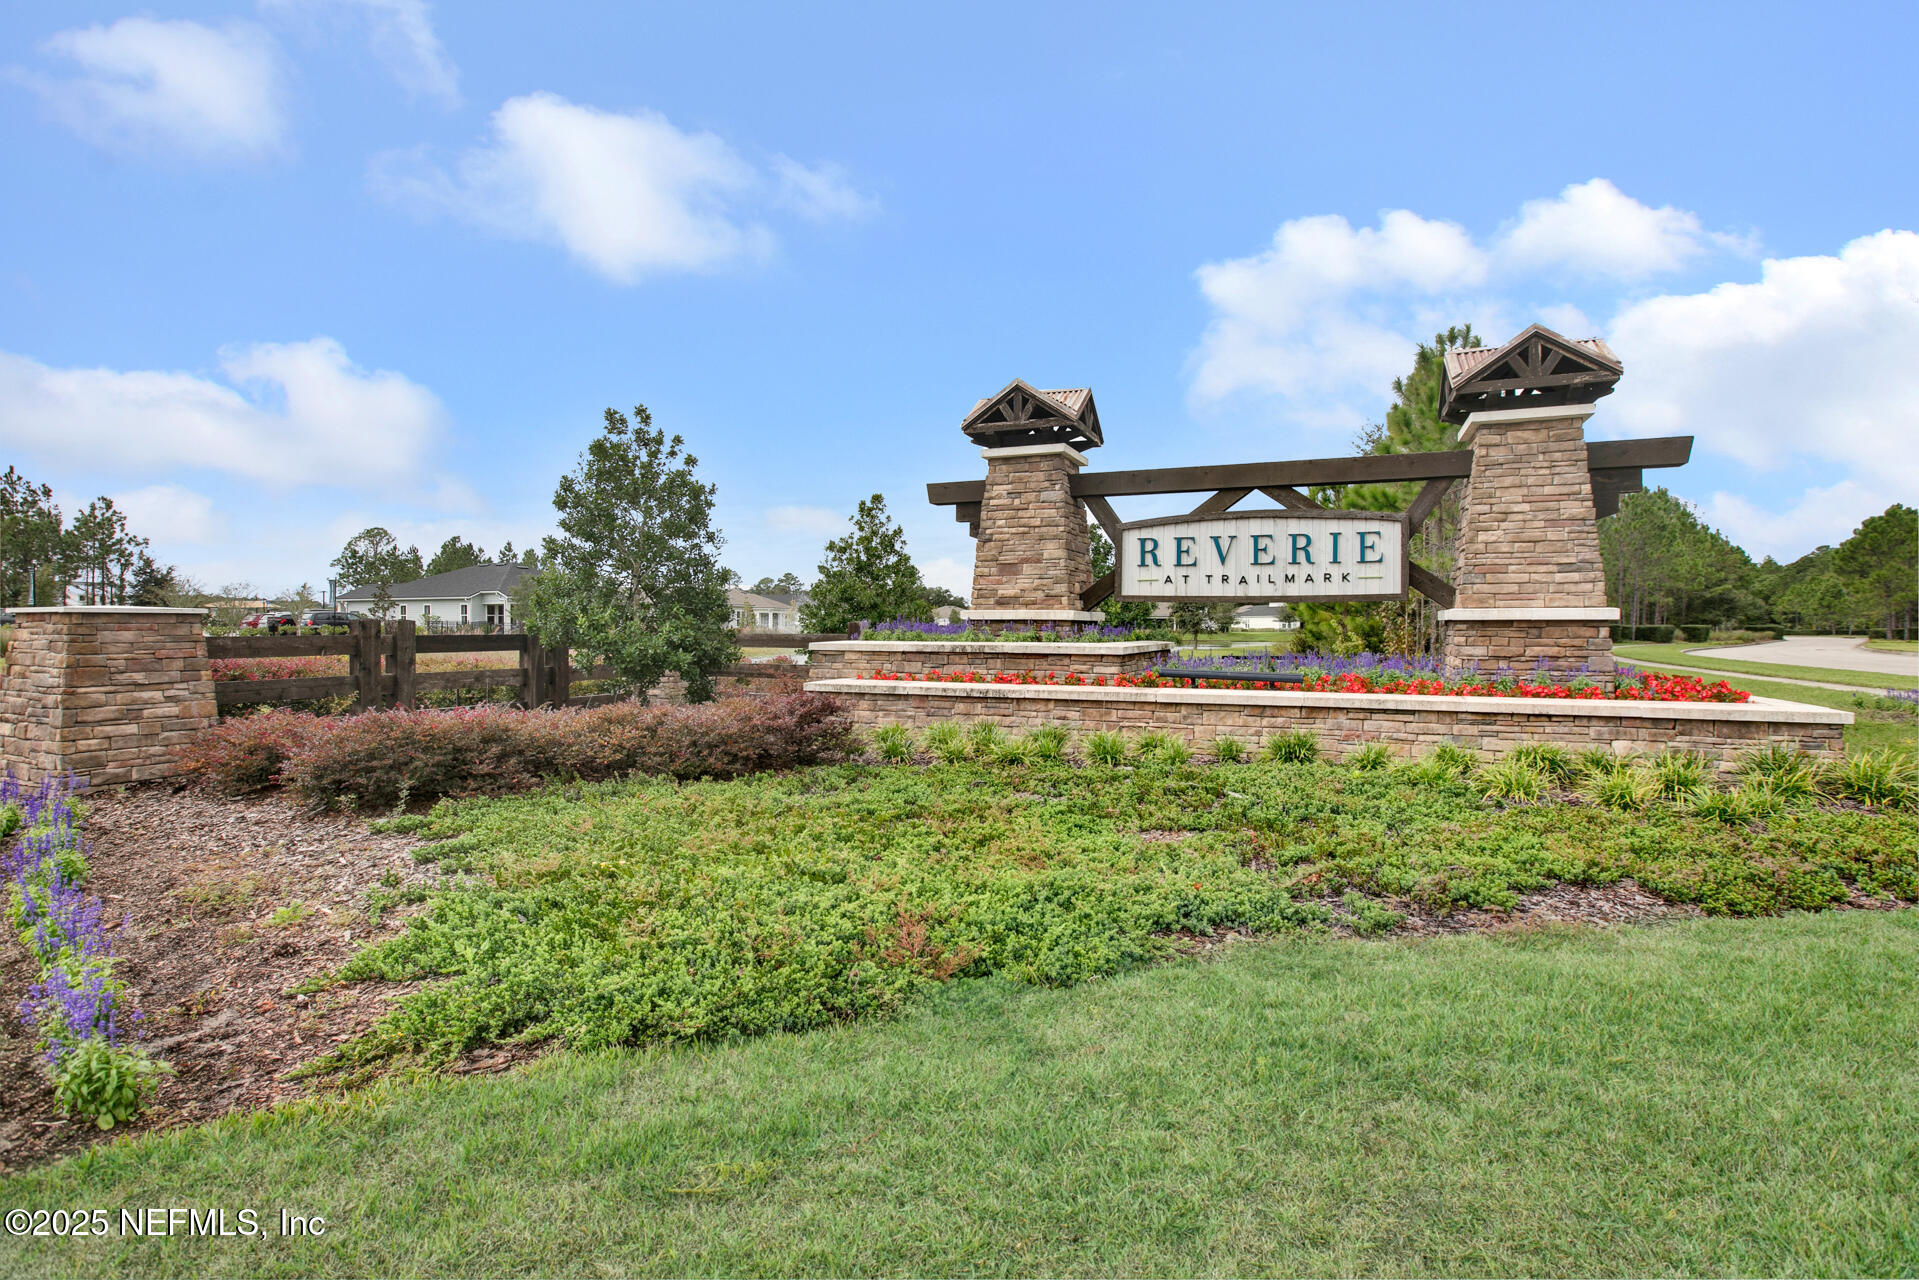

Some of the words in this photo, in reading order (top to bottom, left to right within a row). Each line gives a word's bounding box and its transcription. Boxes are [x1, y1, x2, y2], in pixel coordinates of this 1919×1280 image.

[1137, 530, 1384, 567] REVERIE
[1164, 574, 1190, 584] AT
[1205, 572, 1352, 585] TRAILMARK
